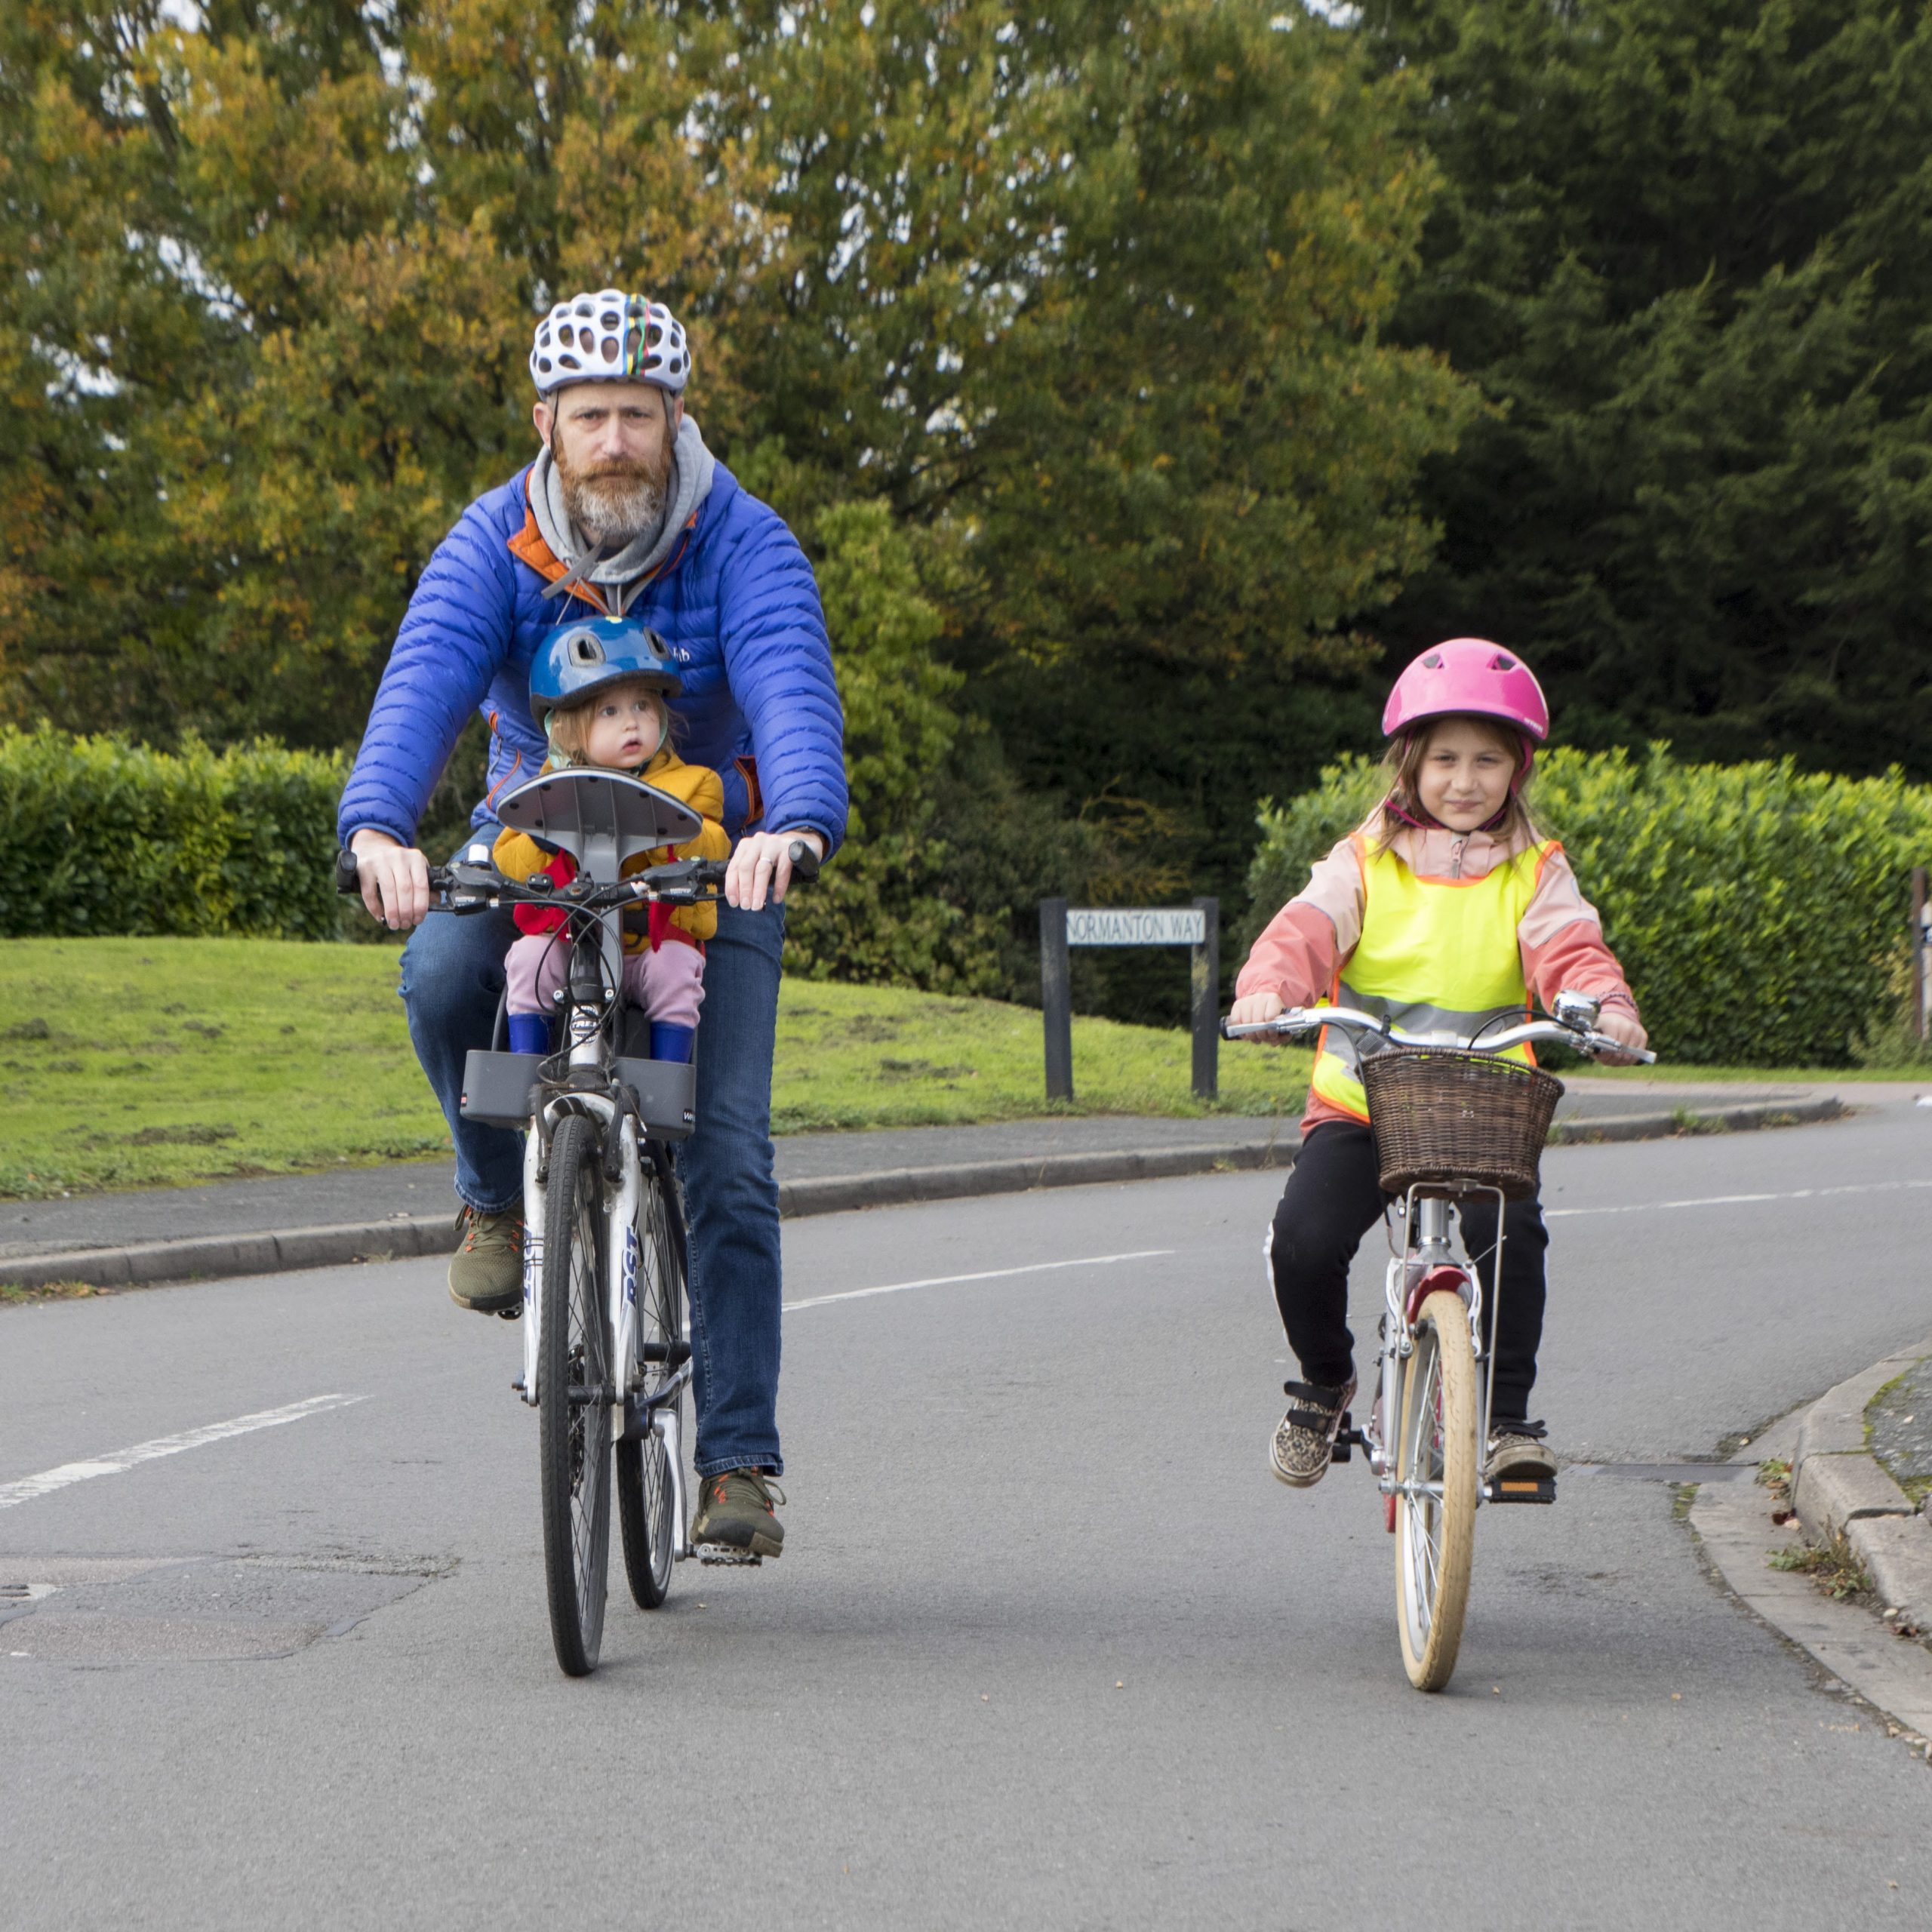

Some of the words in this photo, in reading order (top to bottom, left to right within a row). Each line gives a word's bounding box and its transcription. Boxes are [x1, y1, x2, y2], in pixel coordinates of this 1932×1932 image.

[1066, 914, 1164, 940] NORMANTON
[1171, 914, 1202, 940] WAY
[626, 1226, 638, 1309] RST
